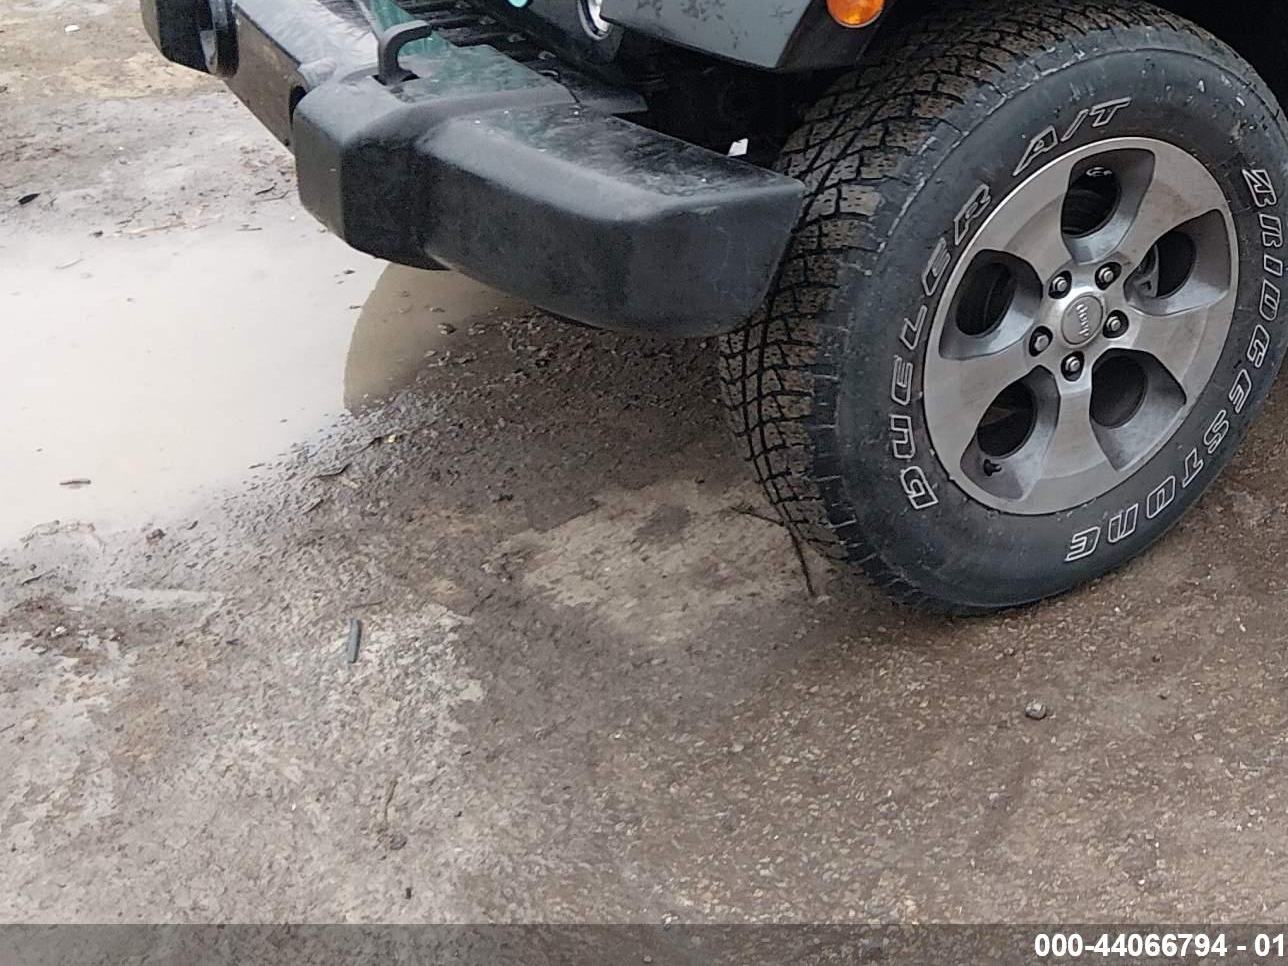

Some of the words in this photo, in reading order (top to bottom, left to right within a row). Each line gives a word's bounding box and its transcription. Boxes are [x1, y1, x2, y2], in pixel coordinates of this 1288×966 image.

[1012, 96, 1132, 176] A/T
[890, 183, 992, 510] DUELER
[1064, 168, 1284, 563] BRIDGESTONE
